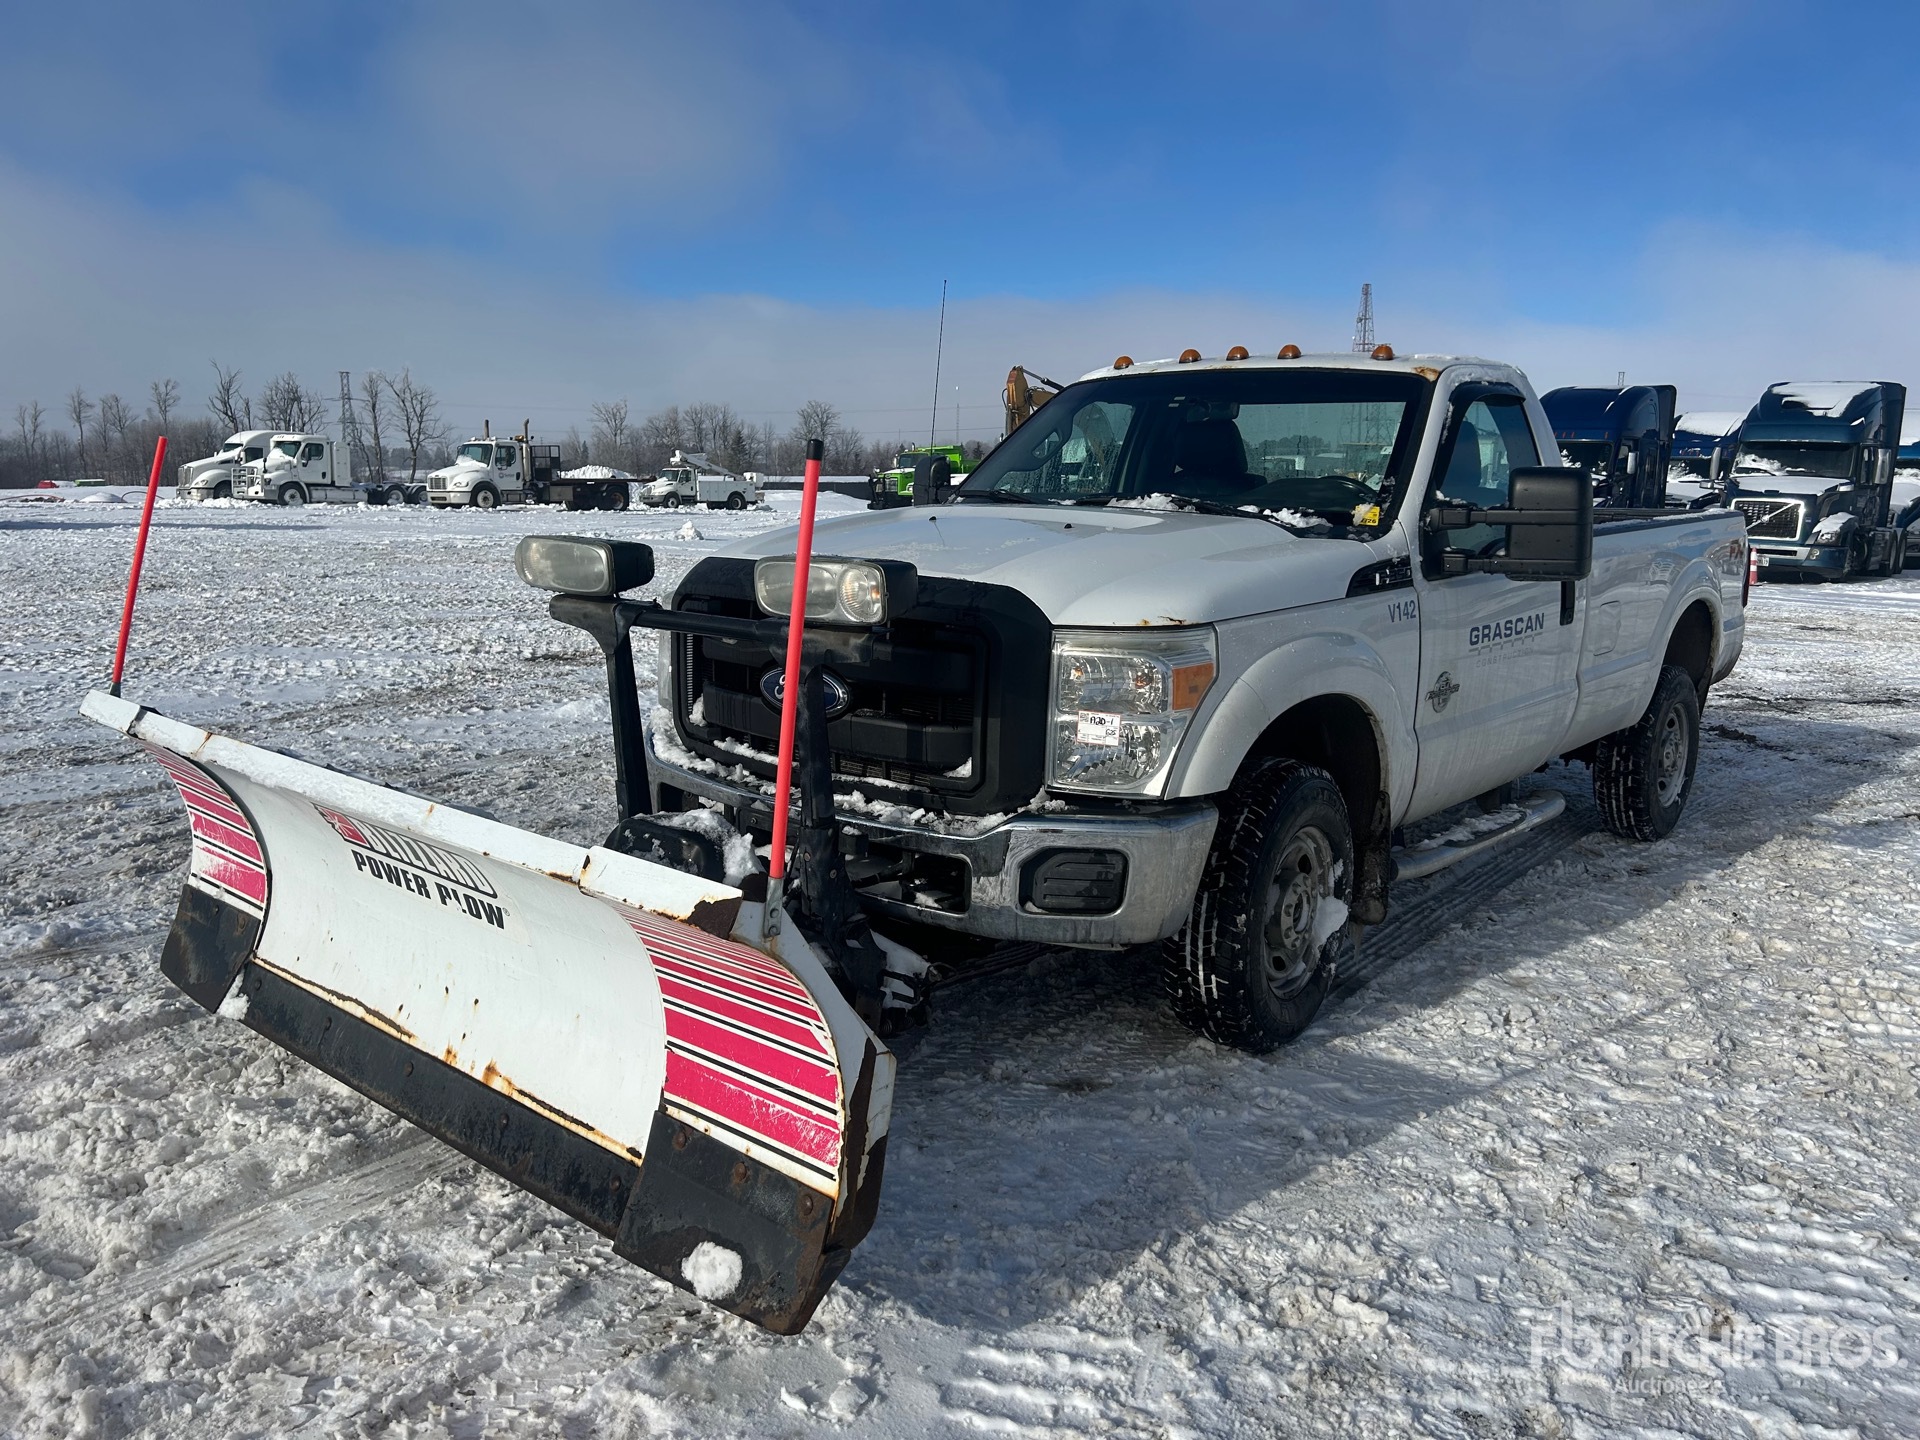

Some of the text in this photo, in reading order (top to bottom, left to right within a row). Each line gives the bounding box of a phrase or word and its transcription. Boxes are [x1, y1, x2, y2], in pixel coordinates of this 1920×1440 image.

[1387, 599, 1417, 623] V142
[1468, 612, 1545, 646] GRASCAN
[347, 815, 496, 897] BLIZZARD
[351, 849, 432, 900] POWER
